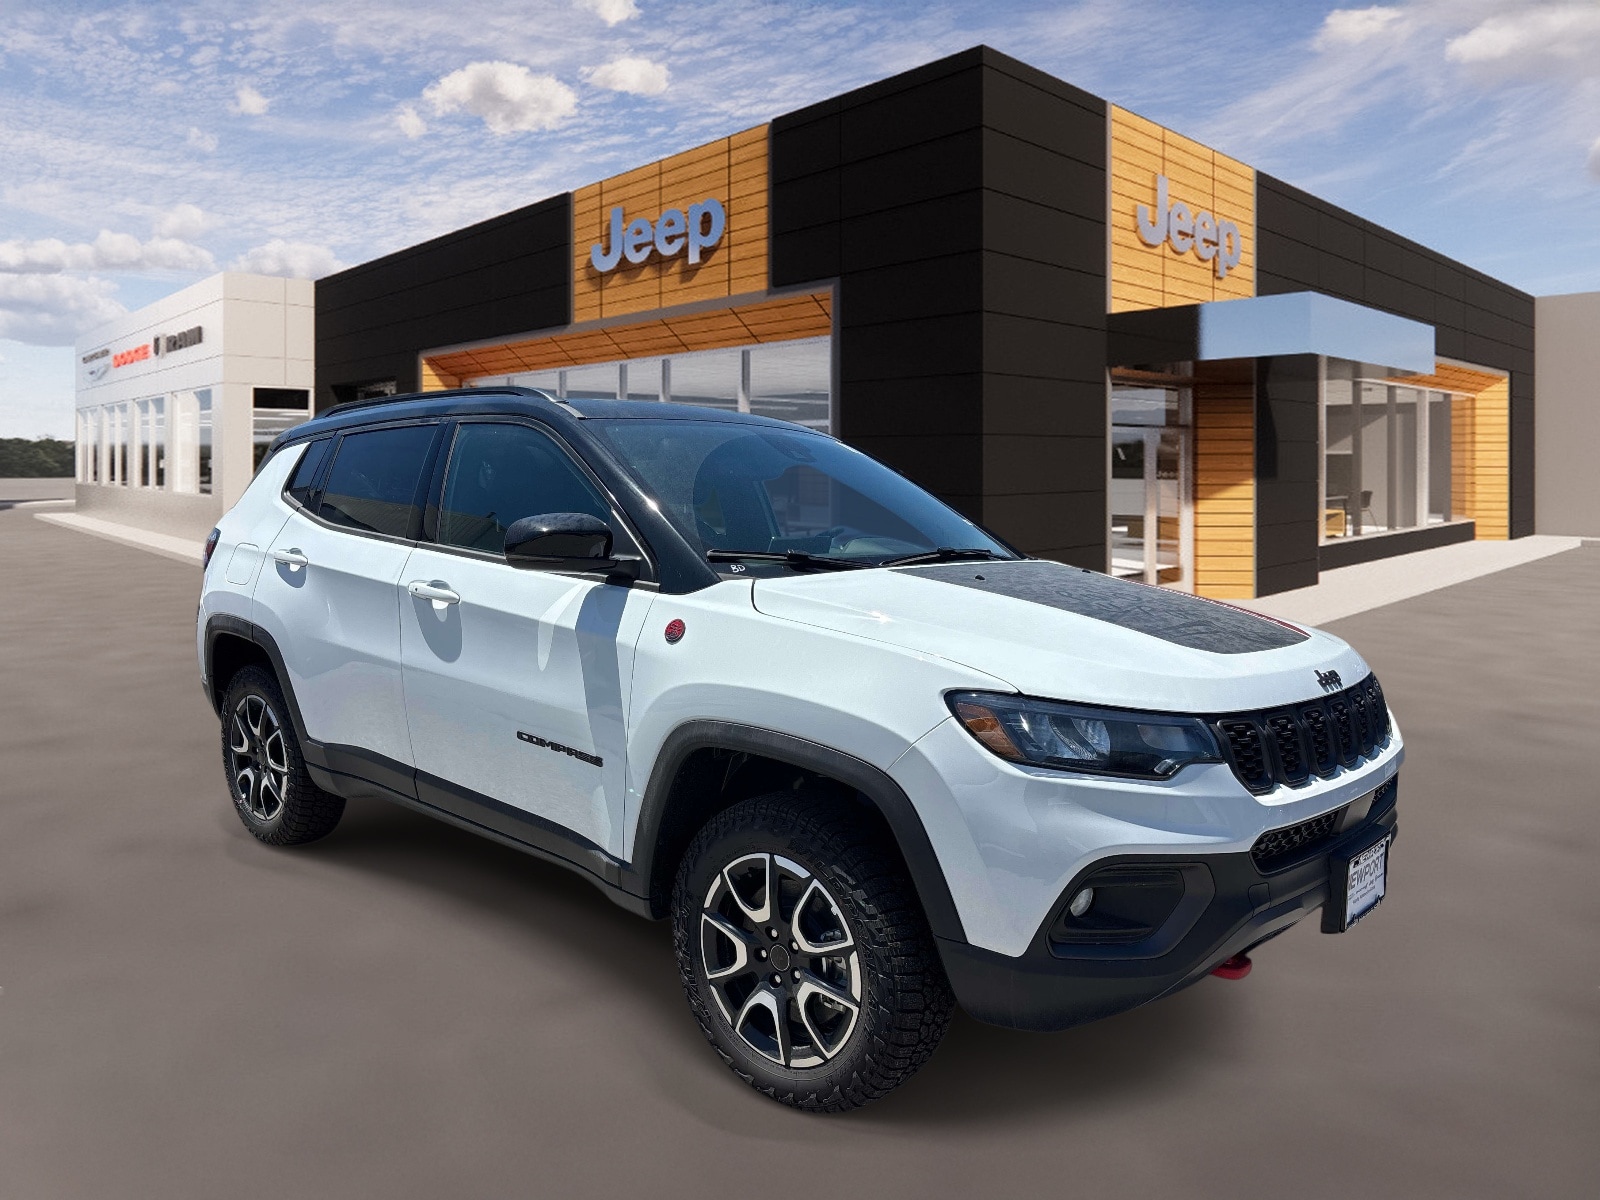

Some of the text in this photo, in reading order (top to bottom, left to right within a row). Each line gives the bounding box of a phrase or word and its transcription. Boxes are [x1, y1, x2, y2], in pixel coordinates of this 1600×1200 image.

[591, 197, 726, 273] Jeep
[1136, 172, 1242, 279] Jeep
[165, 325, 203, 354] RAM
[730, 564, 746, 573] BD
[1313, 669, 1342, 688] Jeep
